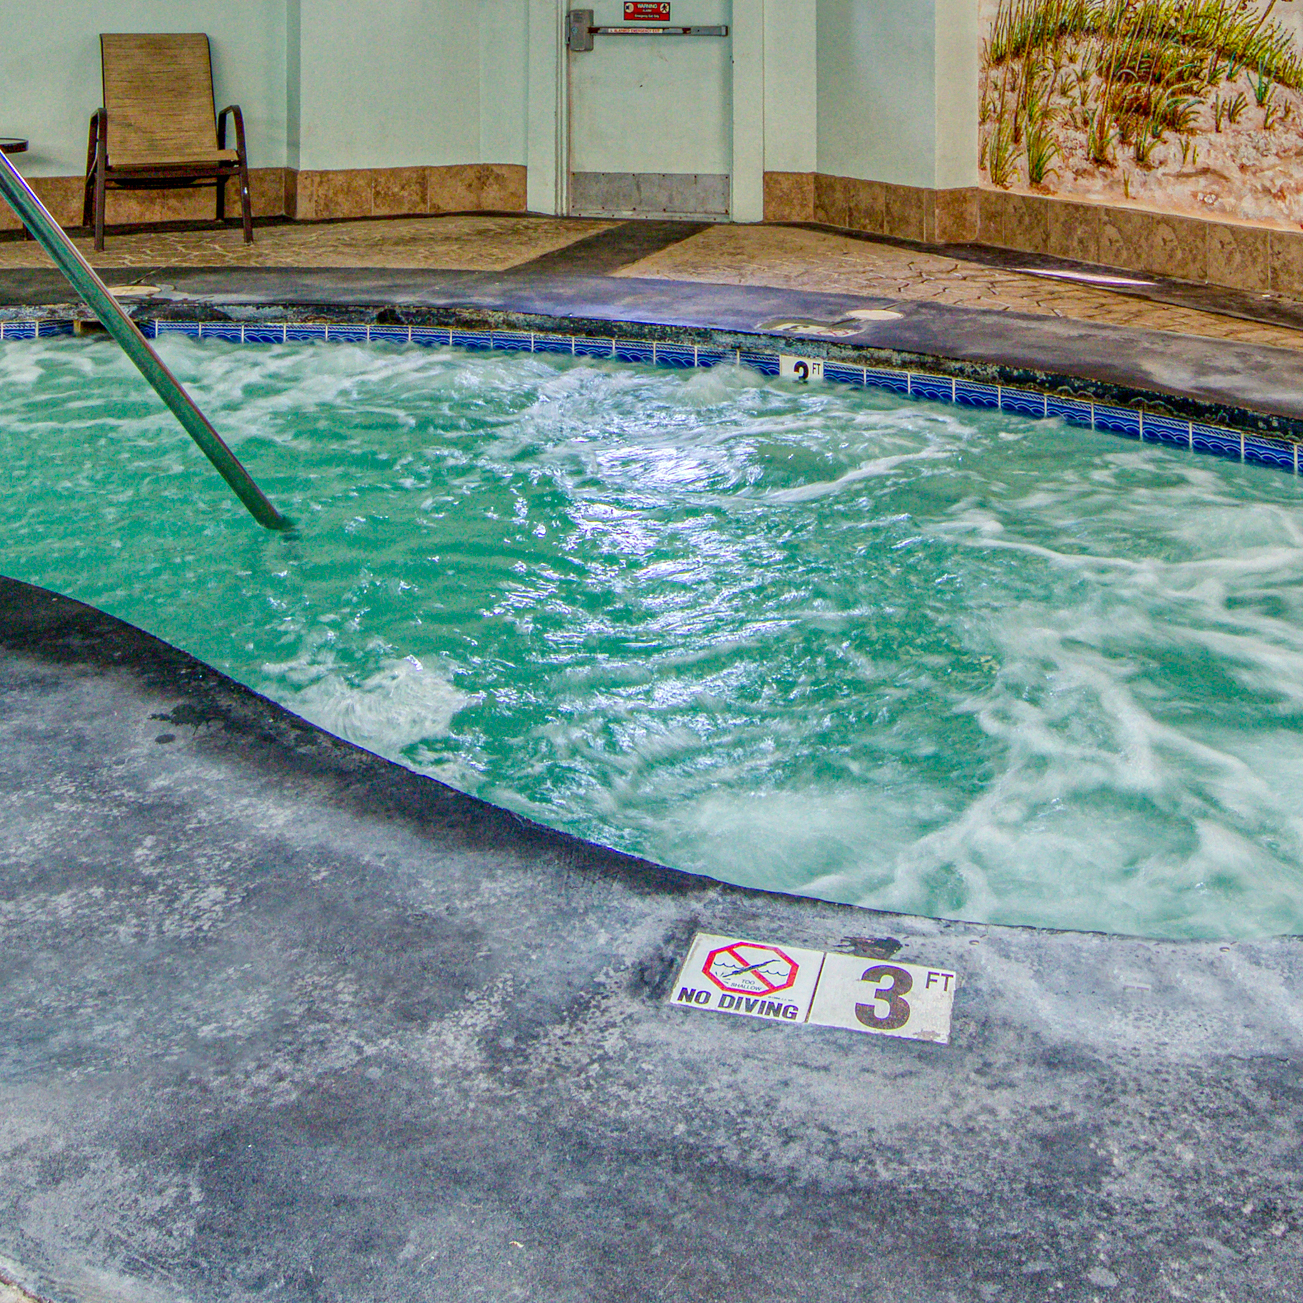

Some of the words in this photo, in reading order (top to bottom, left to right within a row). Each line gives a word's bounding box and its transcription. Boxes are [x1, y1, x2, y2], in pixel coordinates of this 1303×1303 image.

[812, 363, 821, 375] FT
[730, 982, 762, 991] SHALLOW
[925, 972, 954, 992] FT
[677, 987, 711, 1004] NO
[718, 994, 799, 1020] DIVING
[854, 964, 913, 1030] 3
